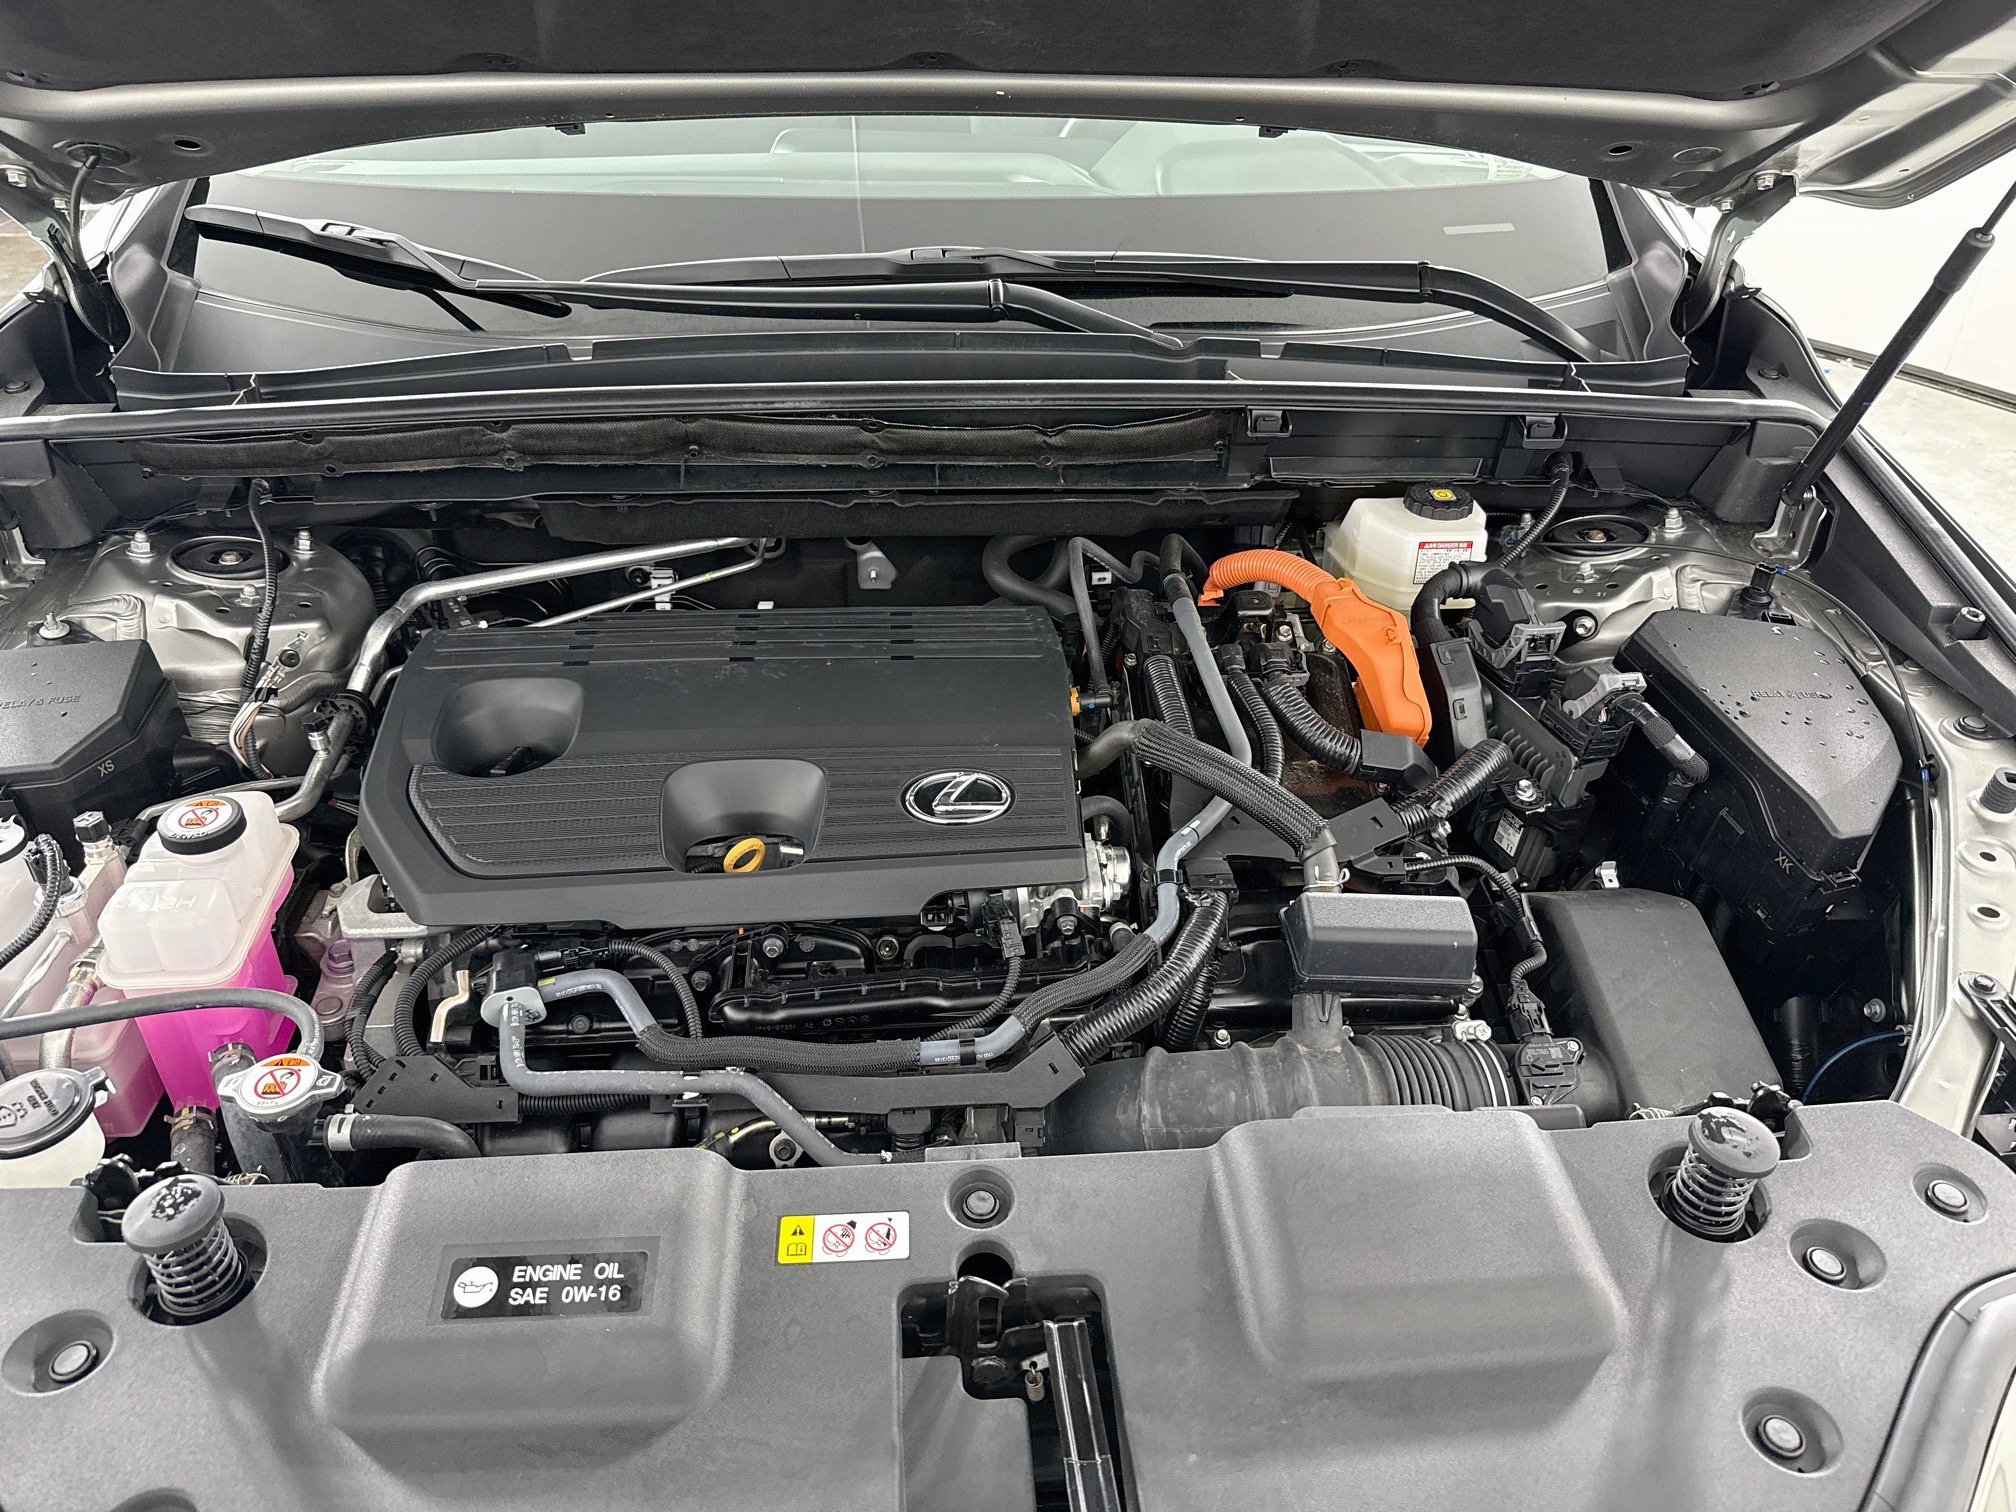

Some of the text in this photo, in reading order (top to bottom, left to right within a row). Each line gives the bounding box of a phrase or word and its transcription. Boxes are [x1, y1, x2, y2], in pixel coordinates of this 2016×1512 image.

[48, 695, 82, 705] FUSE
[97, 759, 115, 778] XS
[1774, 850, 1794, 875] XK
[512, 1262, 625, 1283] ENGINE OIL
[508, 1284, 622, 1306] SAE 0W-16
